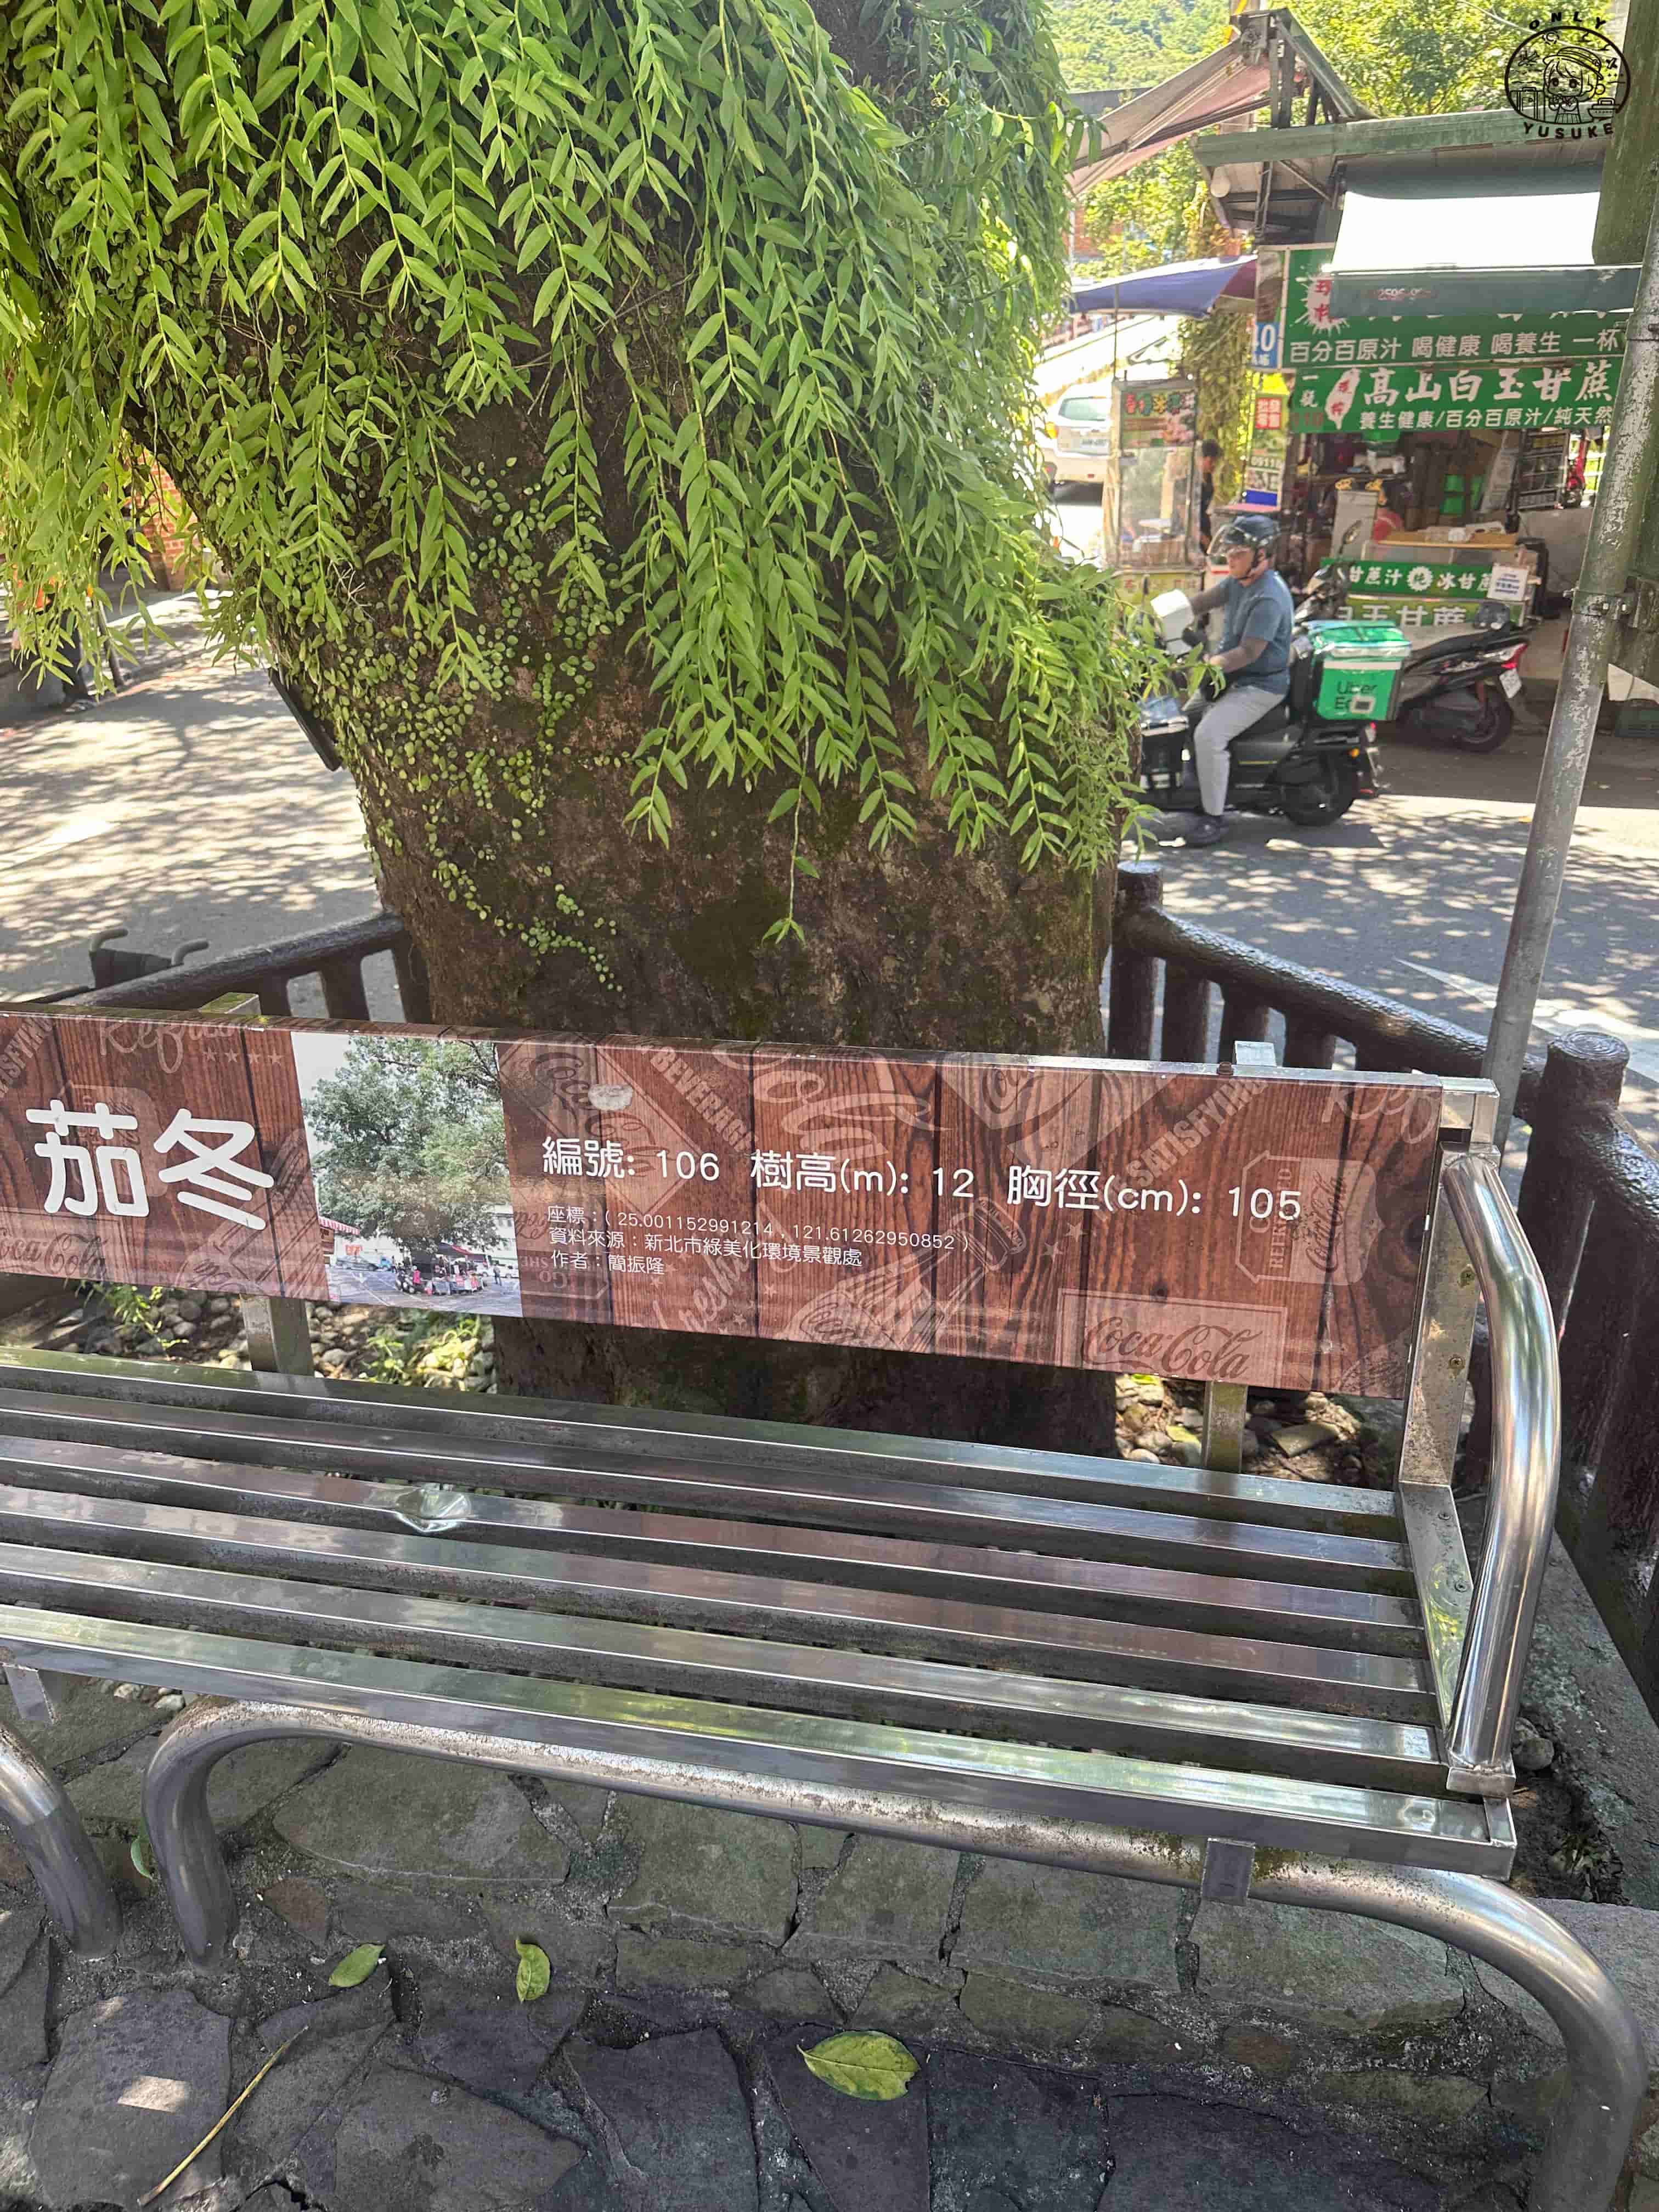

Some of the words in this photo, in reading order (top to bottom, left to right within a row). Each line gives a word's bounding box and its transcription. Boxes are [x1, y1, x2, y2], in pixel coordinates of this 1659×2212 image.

[1290, 337, 1402, 363] 百分百原汁
[1412, 335, 1481, 359] 喝健康
[1491, 331, 1561, 355] 喝養生
[1572, 329, 1621, 352] 一杯
[1364, 359, 1613, 407] 高山白玉甘蔗
[1337, 566, 1403, 586] 甘蔗汁
[26, 1099, 274, 1231] 茄冬
[542, 1136, 635, 1179] 編號:
[657, 1150, 720, 1181] 106
[750, 1149, 909, 1195] 樹高(m):
[931, 1167, 975, 1199] 12
[1007, 1164, 1202, 1216] 胸徑(cm):
[1228, 1187, 1301, 1221] 105
[617, 1212, 773, 1235] 25.001152991214
[793, 1223, 955, 1250] 121.61262950852
[550, 1250, 665, 1276] 作者：簡振隆
[1081, 1316, 1263, 1379] Coca-Cola
